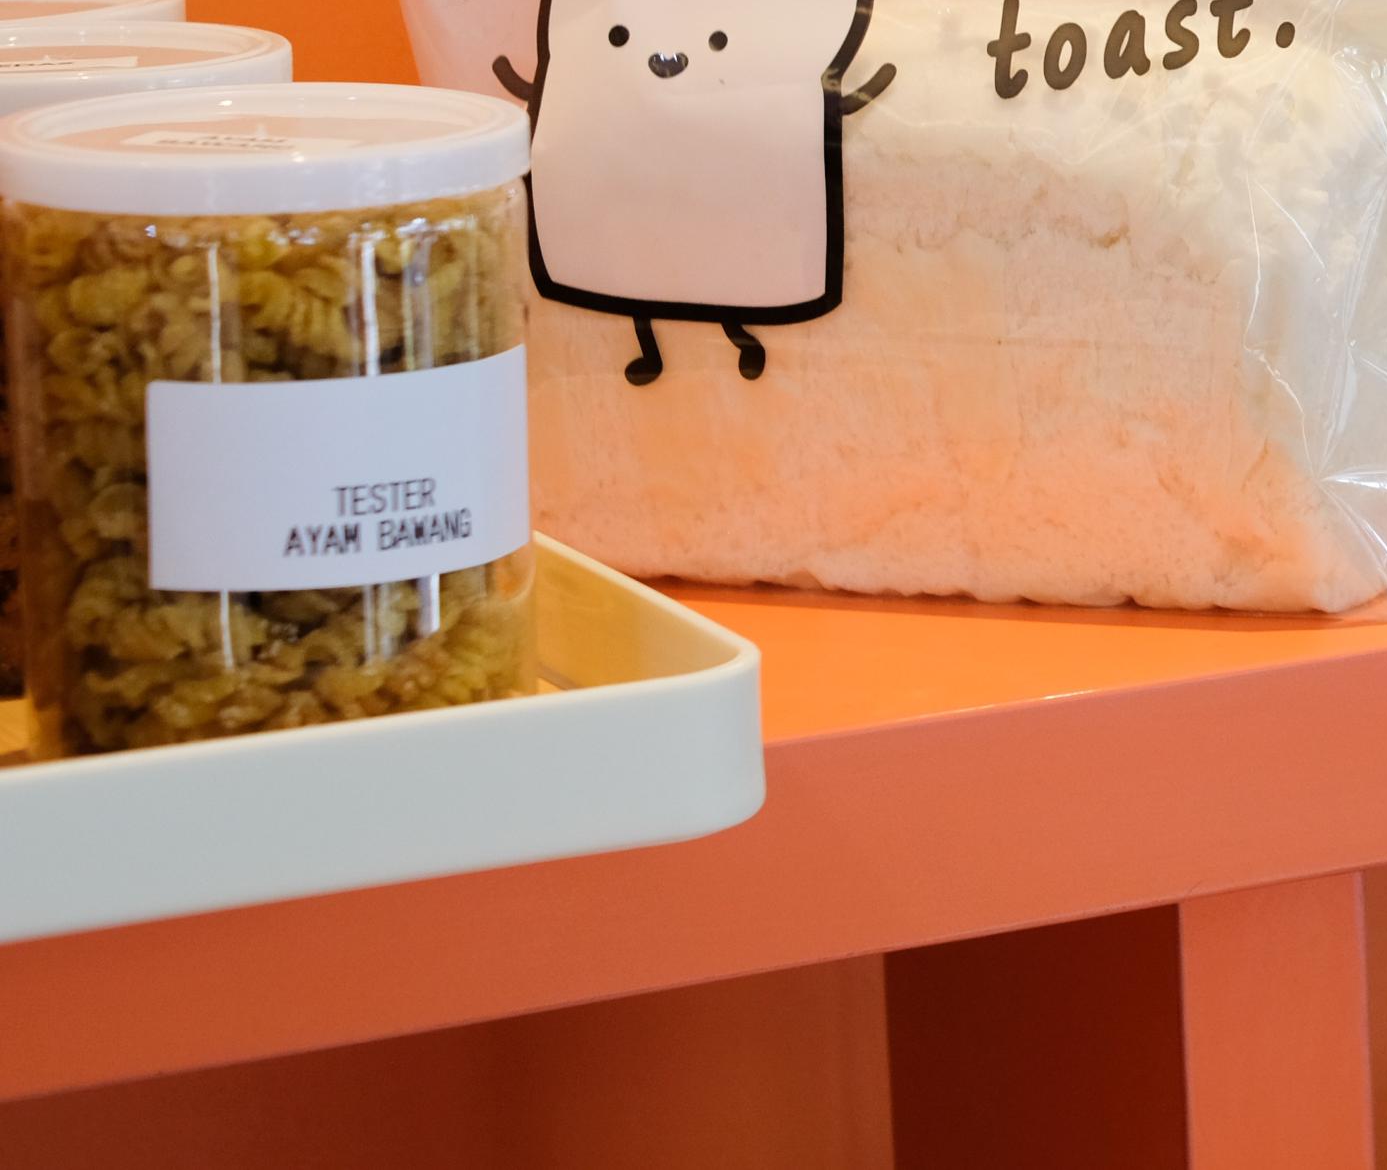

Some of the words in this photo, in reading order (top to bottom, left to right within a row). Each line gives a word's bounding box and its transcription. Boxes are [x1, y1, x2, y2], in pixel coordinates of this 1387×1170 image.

[332, 477, 437, 517] TESTER
[283, 522, 361, 558] AYAM
[377, 506, 473, 552] BAWANG
